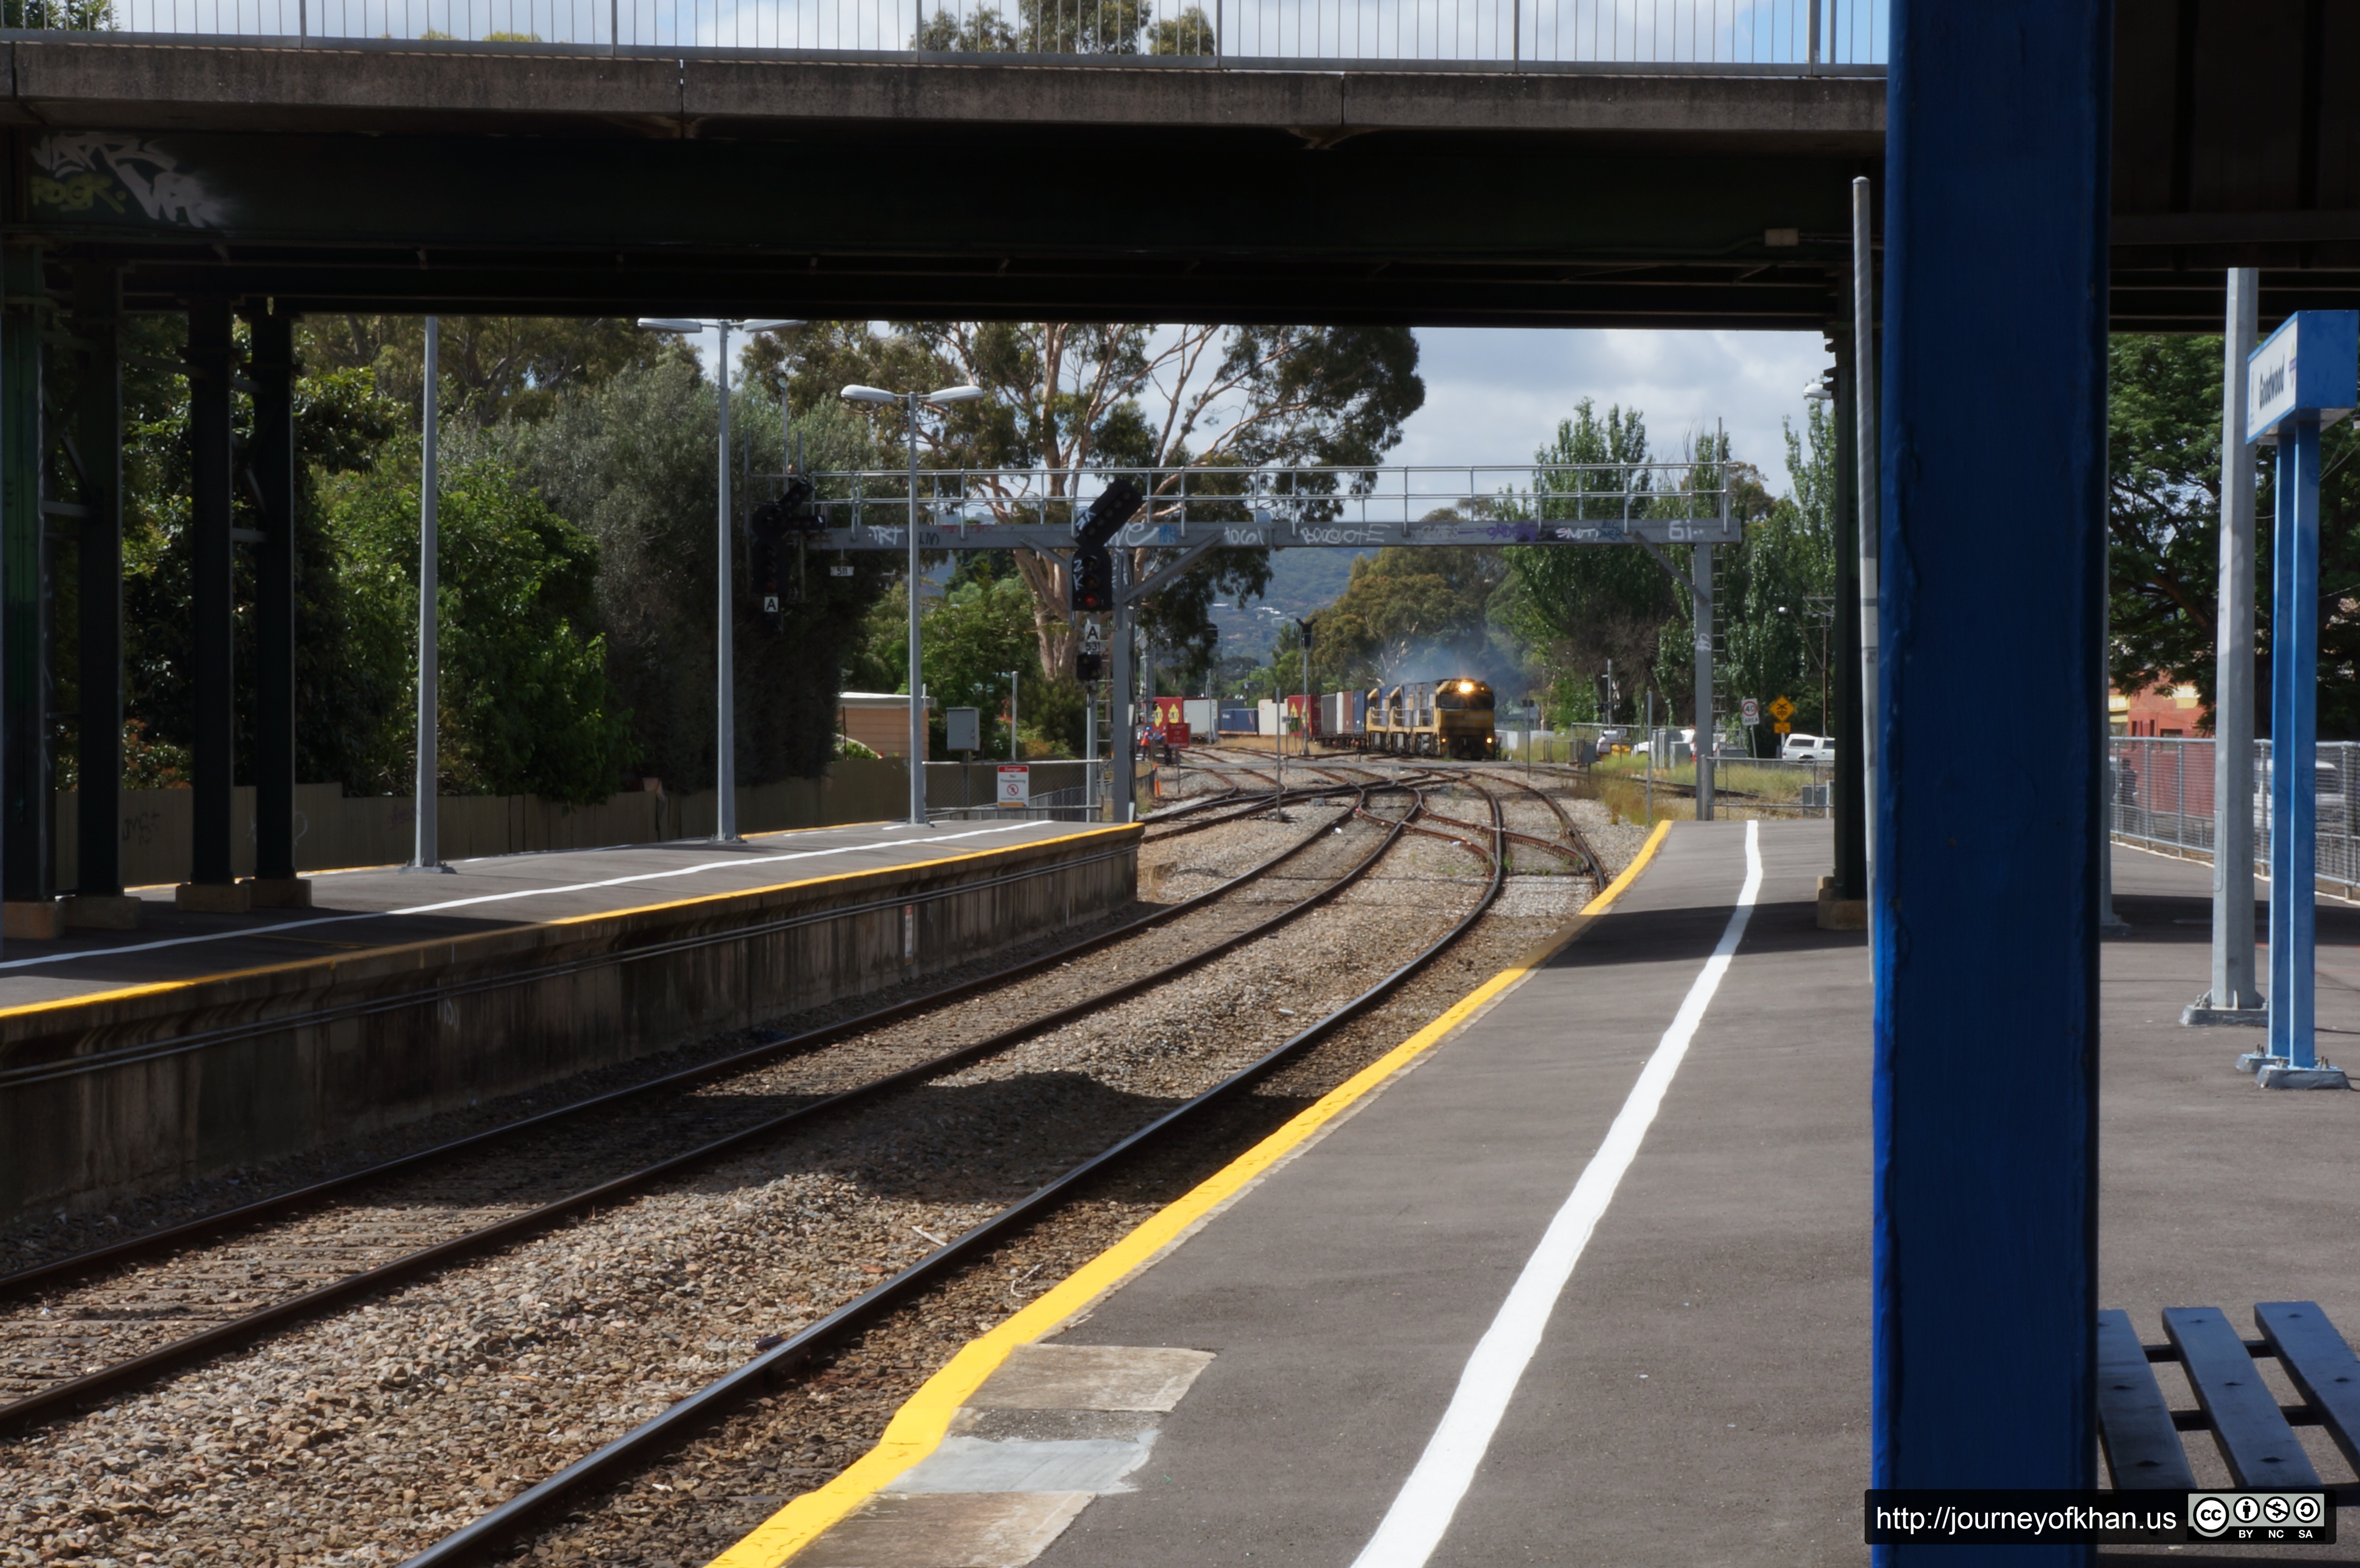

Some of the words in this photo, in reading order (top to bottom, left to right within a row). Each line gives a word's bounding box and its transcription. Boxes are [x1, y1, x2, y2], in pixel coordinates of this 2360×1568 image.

[2260, 353, 2285, 411] Goodwood
[766, 598, 776, 611] A
[1087, 625, 1099, 639] A
[1086, 642, 1100, 650] 531
